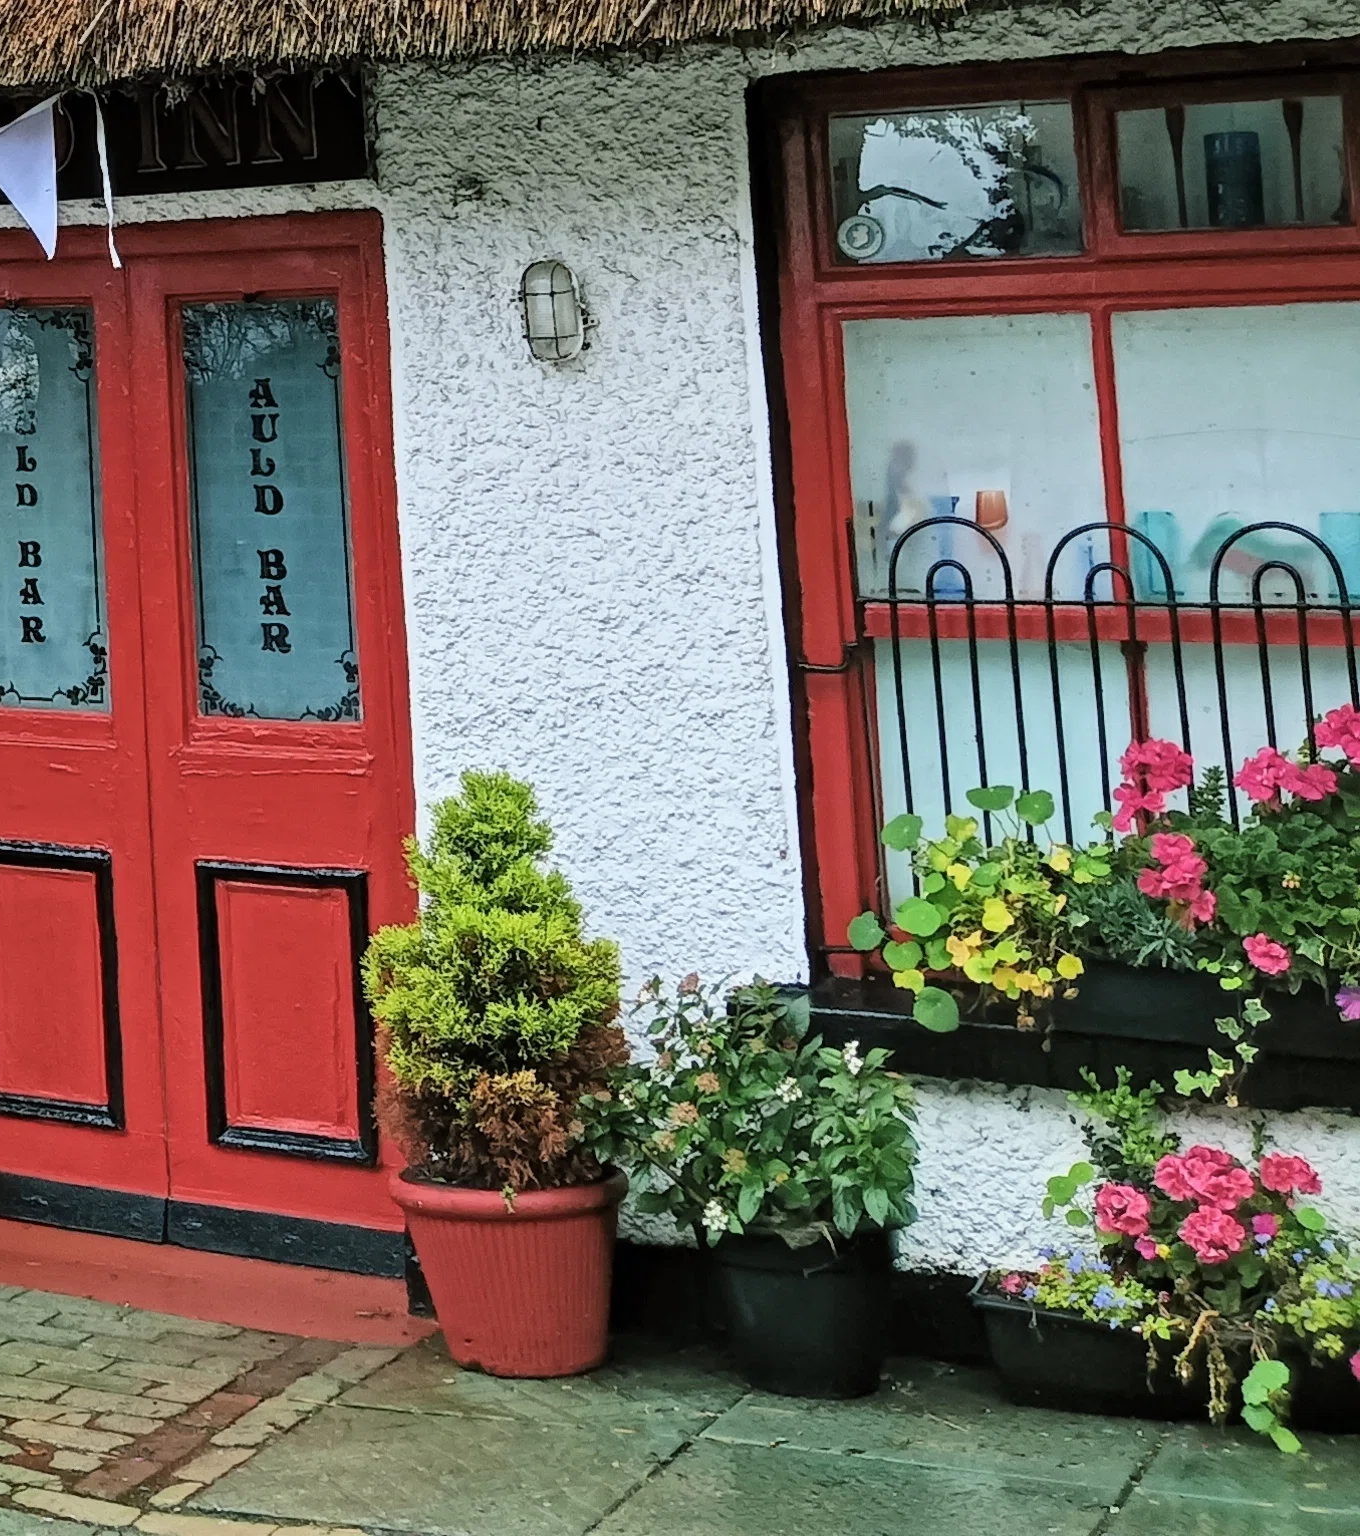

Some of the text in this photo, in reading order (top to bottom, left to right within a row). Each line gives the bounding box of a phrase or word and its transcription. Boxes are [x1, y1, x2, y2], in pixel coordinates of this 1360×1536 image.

[136, 69, 323, 173] INN
[249, 377, 284, 516] AULD
[18, 540, 46, 644] BAR
[259, 549, 292, 654] BAR
